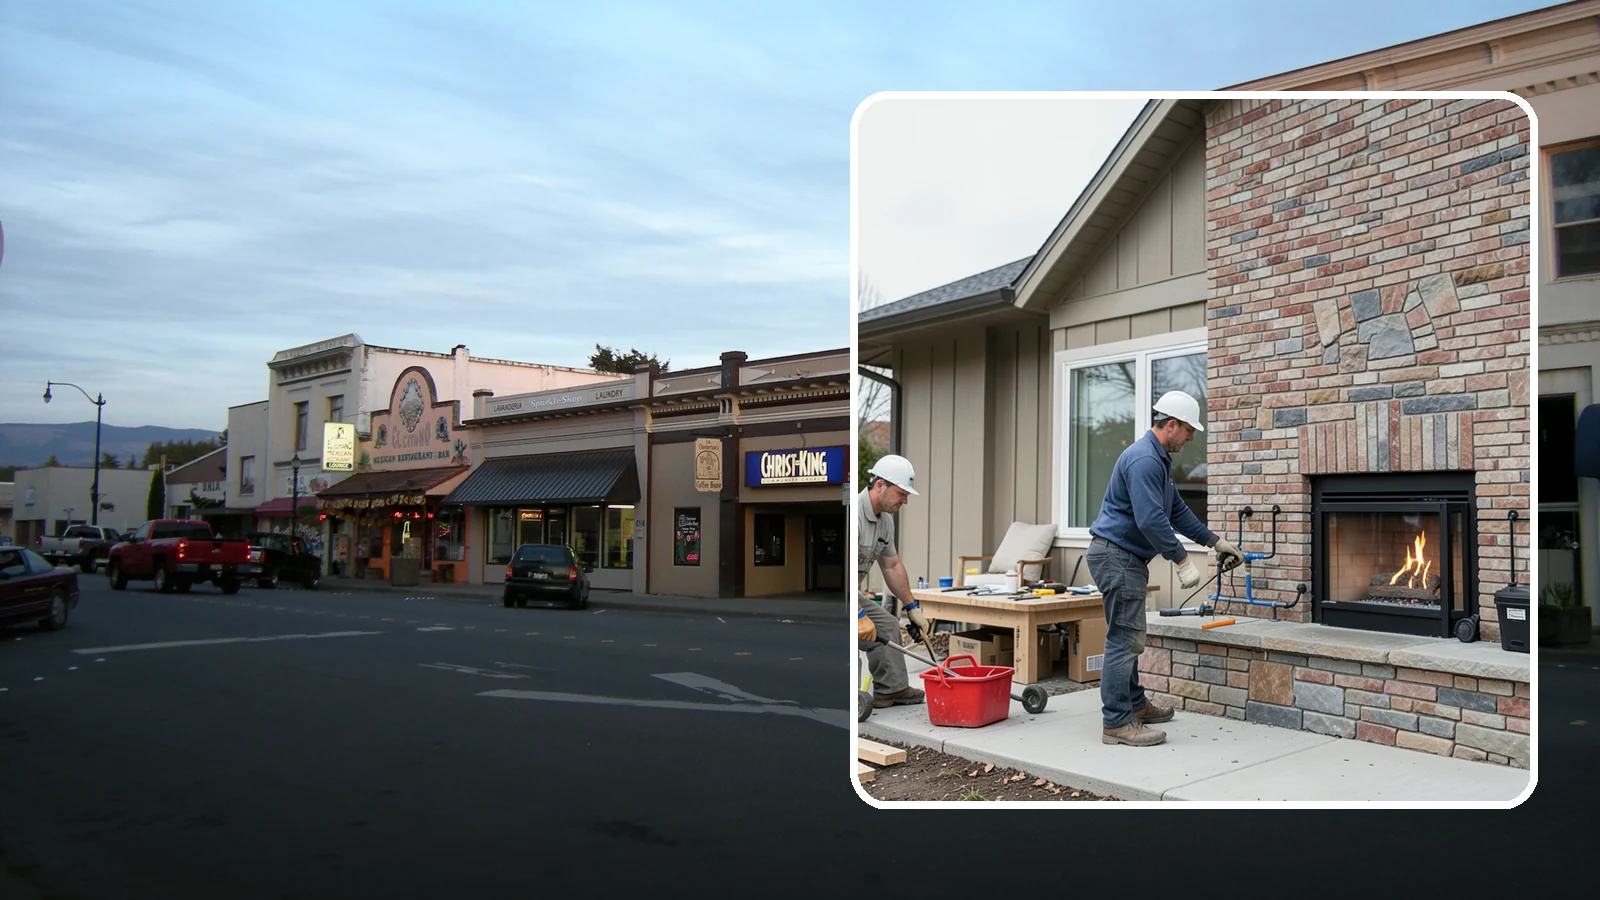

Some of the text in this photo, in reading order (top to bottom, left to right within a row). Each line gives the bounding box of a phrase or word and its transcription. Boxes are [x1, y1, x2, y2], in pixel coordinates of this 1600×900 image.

[531, 394, 583, 409] Sparkle Shop
[595, 389, 624, 400] LAUNDRY
[493, 402, 523, 413] LAVANDERIA
[373, 454, 396, 464] MEXICAN
[397, 450, 434, 462] RESTAURANT
[438, 449, 450, 459] BAR
[761, 450, 827, 478] CHRIST KING
